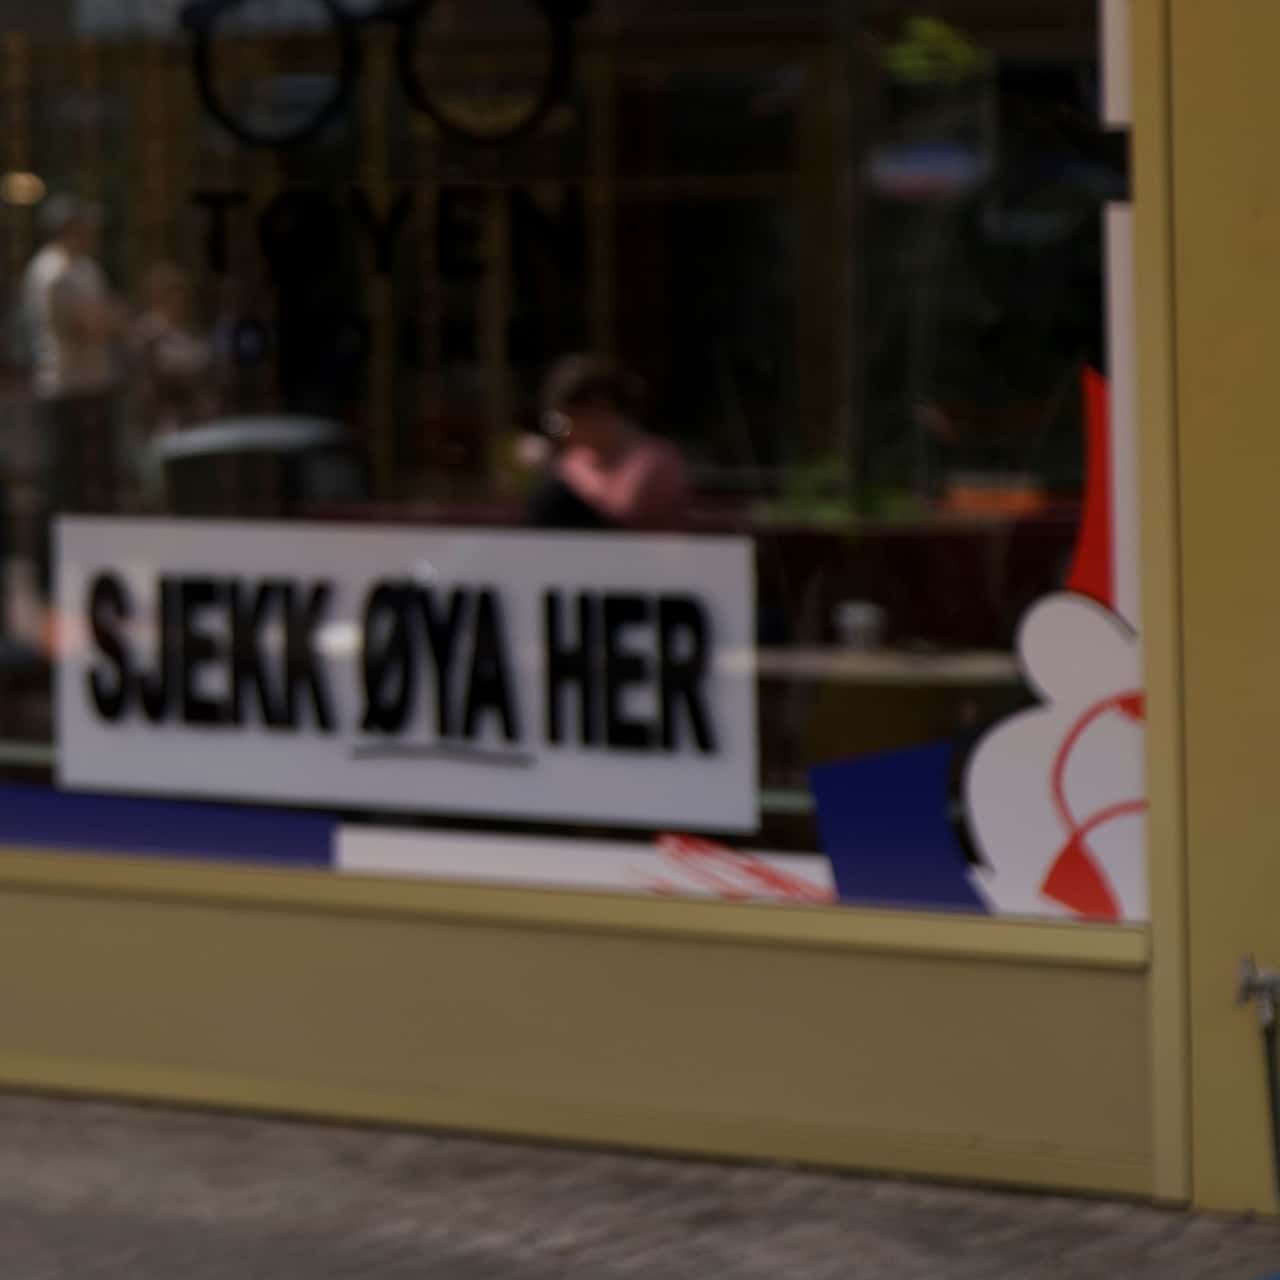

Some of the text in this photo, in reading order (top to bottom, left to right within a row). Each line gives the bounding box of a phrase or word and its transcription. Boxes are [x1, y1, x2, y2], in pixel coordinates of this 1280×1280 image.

[86, 569, 721, 756] SJEKK ØYA HER
